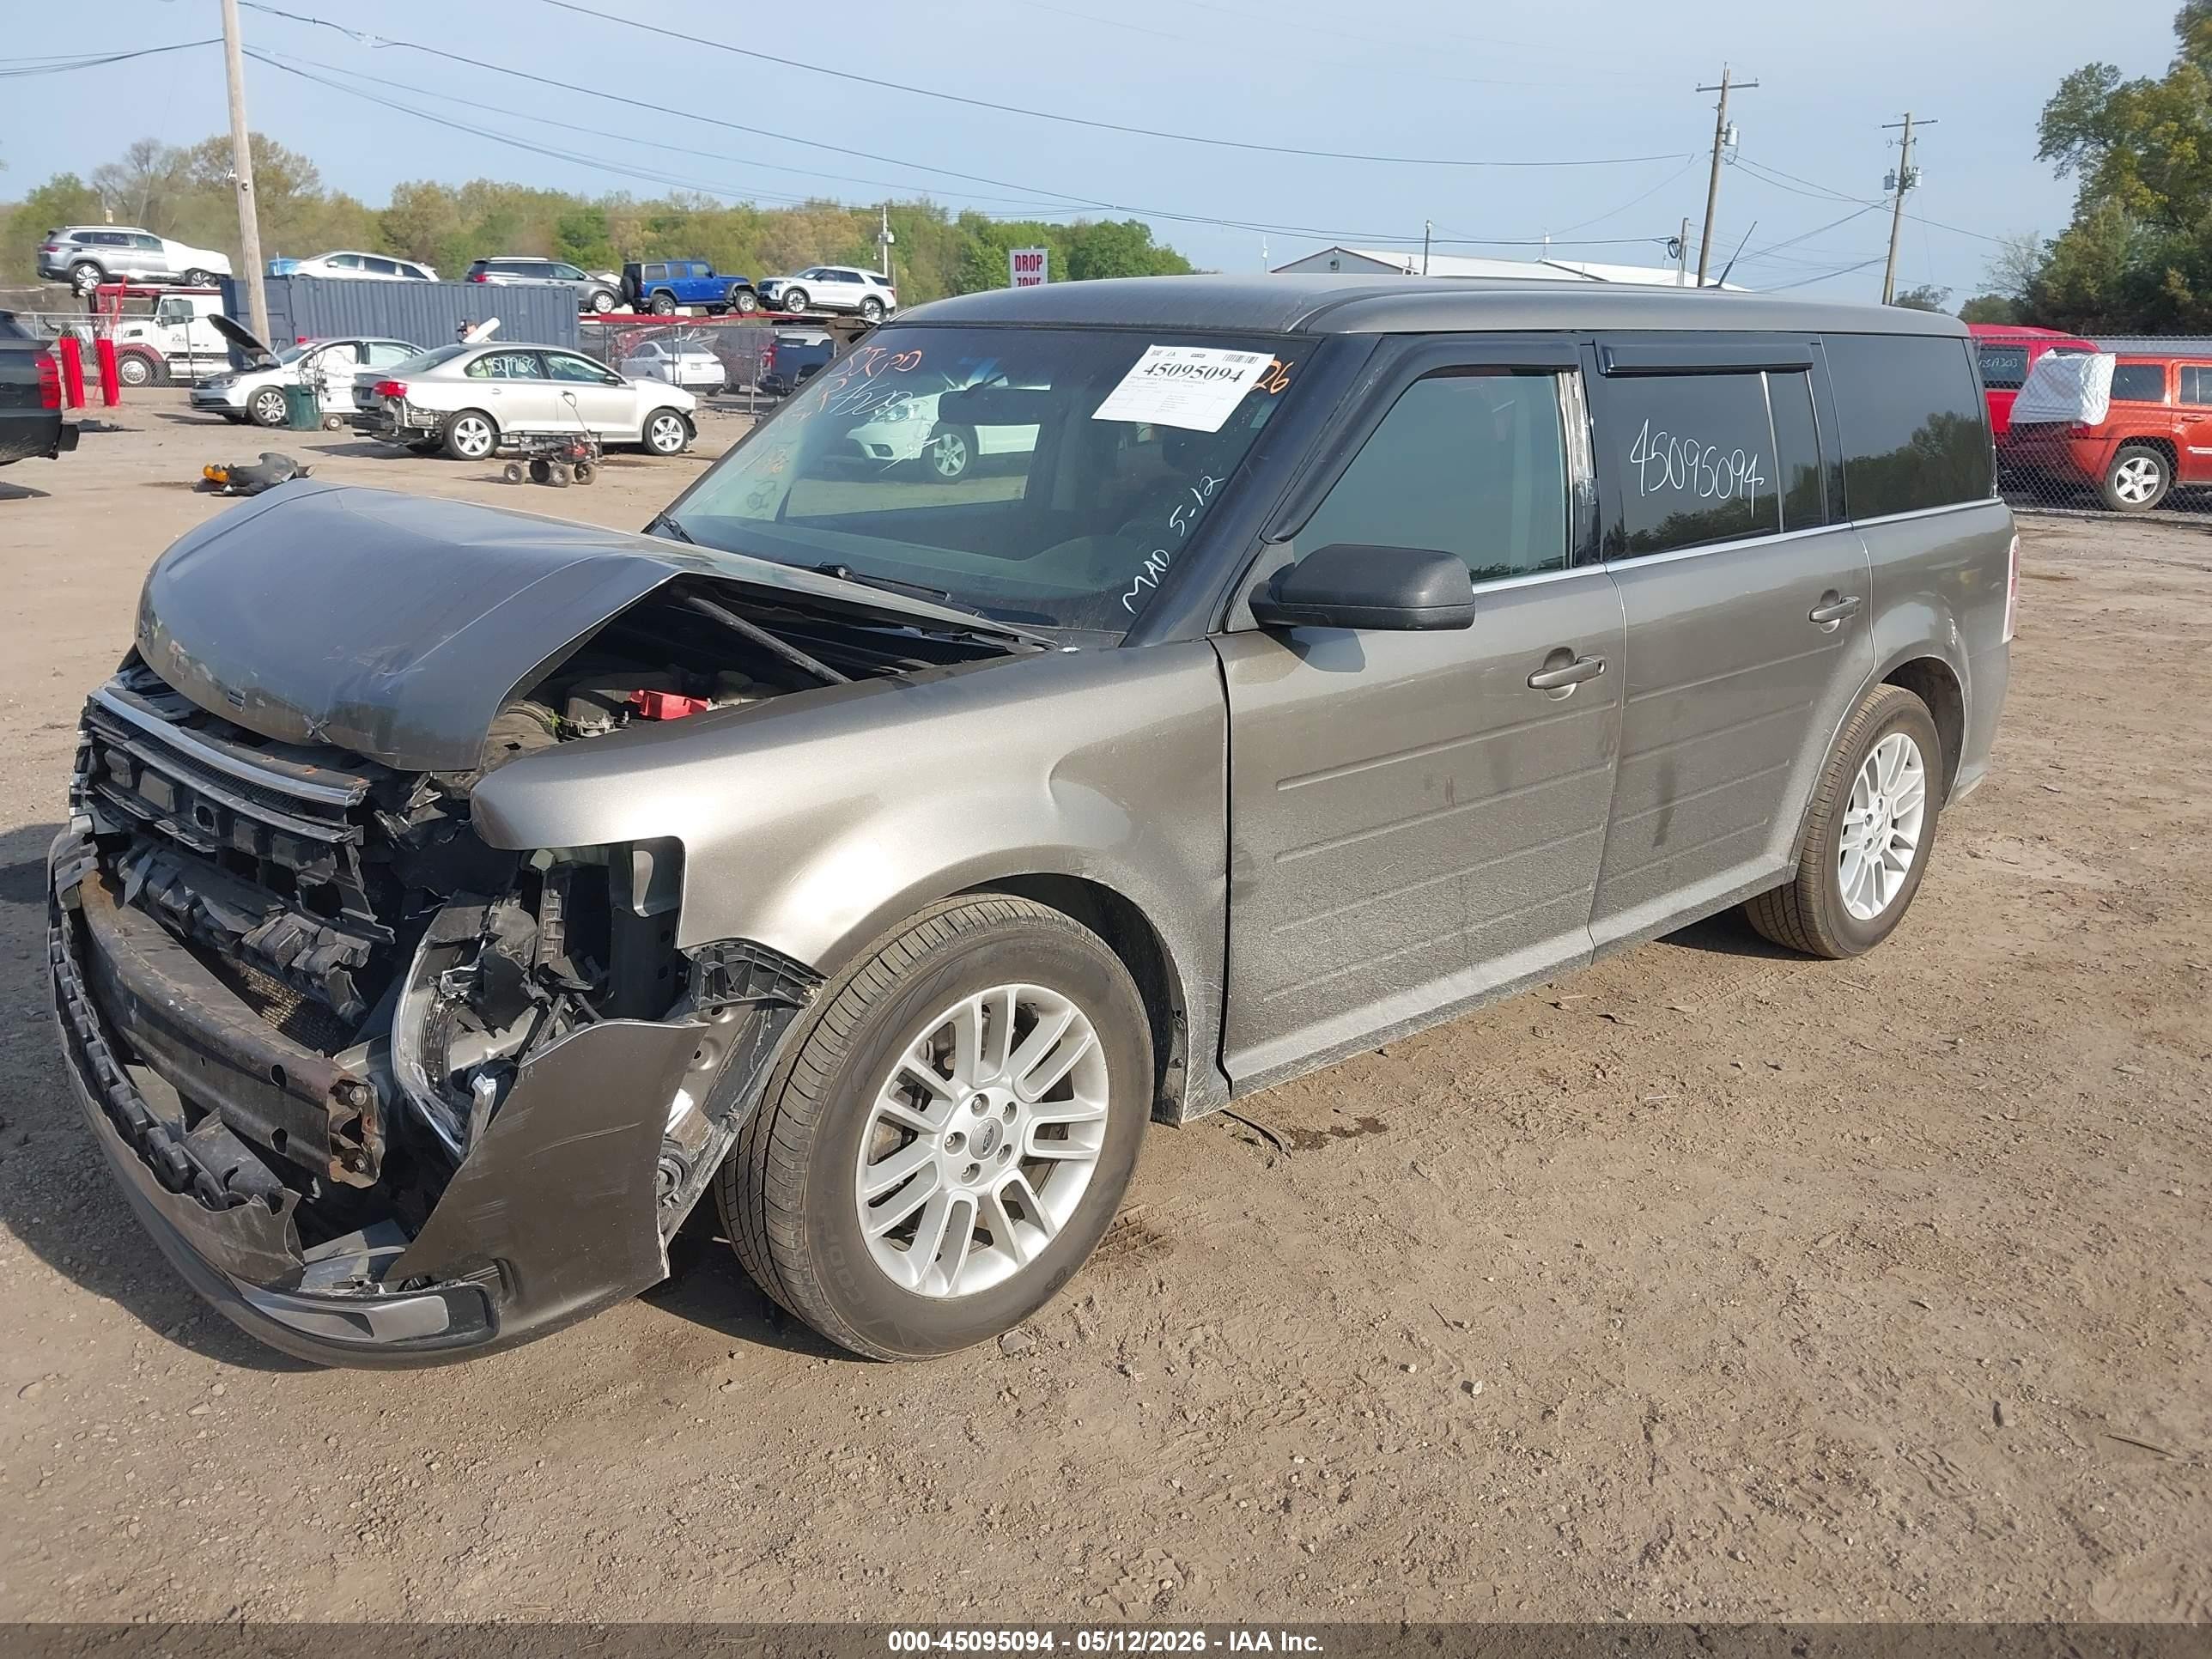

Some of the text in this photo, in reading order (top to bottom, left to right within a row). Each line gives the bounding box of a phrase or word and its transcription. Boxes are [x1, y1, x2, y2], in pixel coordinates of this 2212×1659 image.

[1014, 254, 1043, 272] DROP
[1143, 362, 1246, 383] 45095094
[1629, 418, 1765, 520] 45095094
[1121, 548, 1170, 616] MAD
[1169, 475, 1226, 538] 5-12
